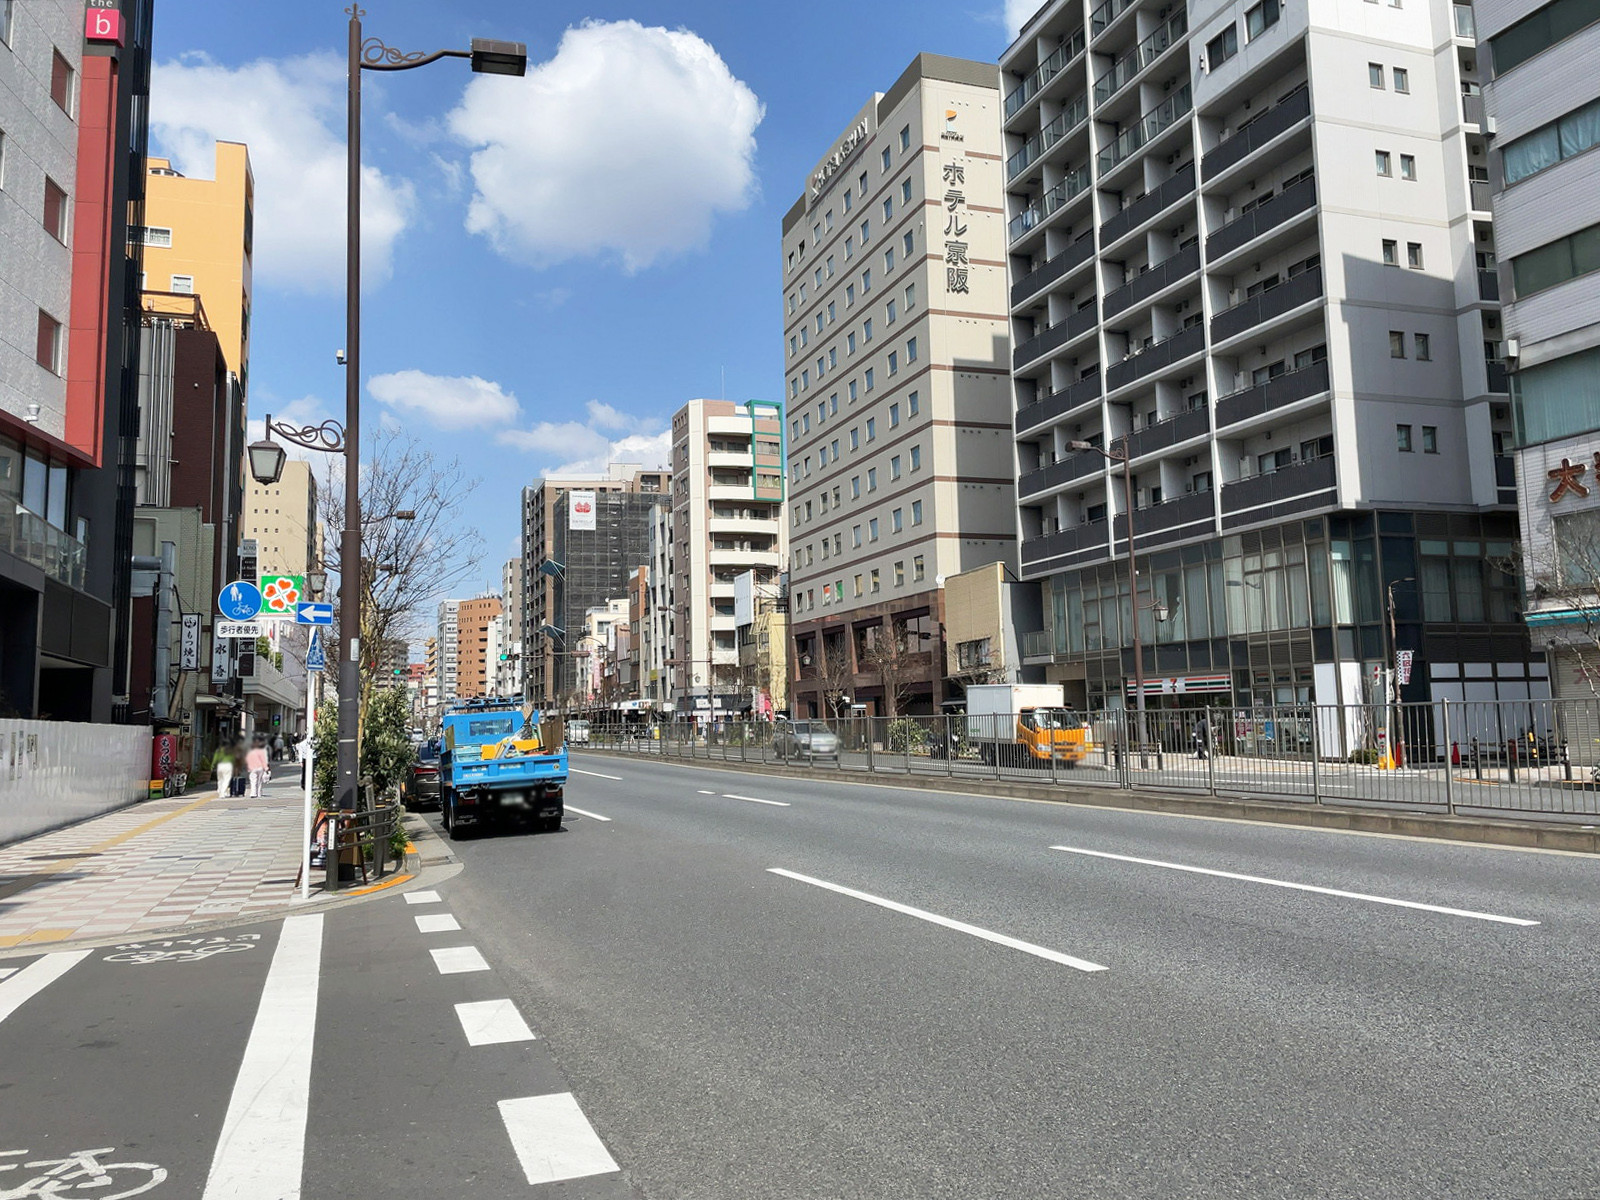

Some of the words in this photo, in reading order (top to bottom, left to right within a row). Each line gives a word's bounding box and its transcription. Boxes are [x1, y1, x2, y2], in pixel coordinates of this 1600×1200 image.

[942, 162, 969, 294] ホテル京阪
[1547, 451, 1600, 503] 大
[183, 631, 195, 669] もつ焼き
[220, 625, 259, 635] 歩行者優先
